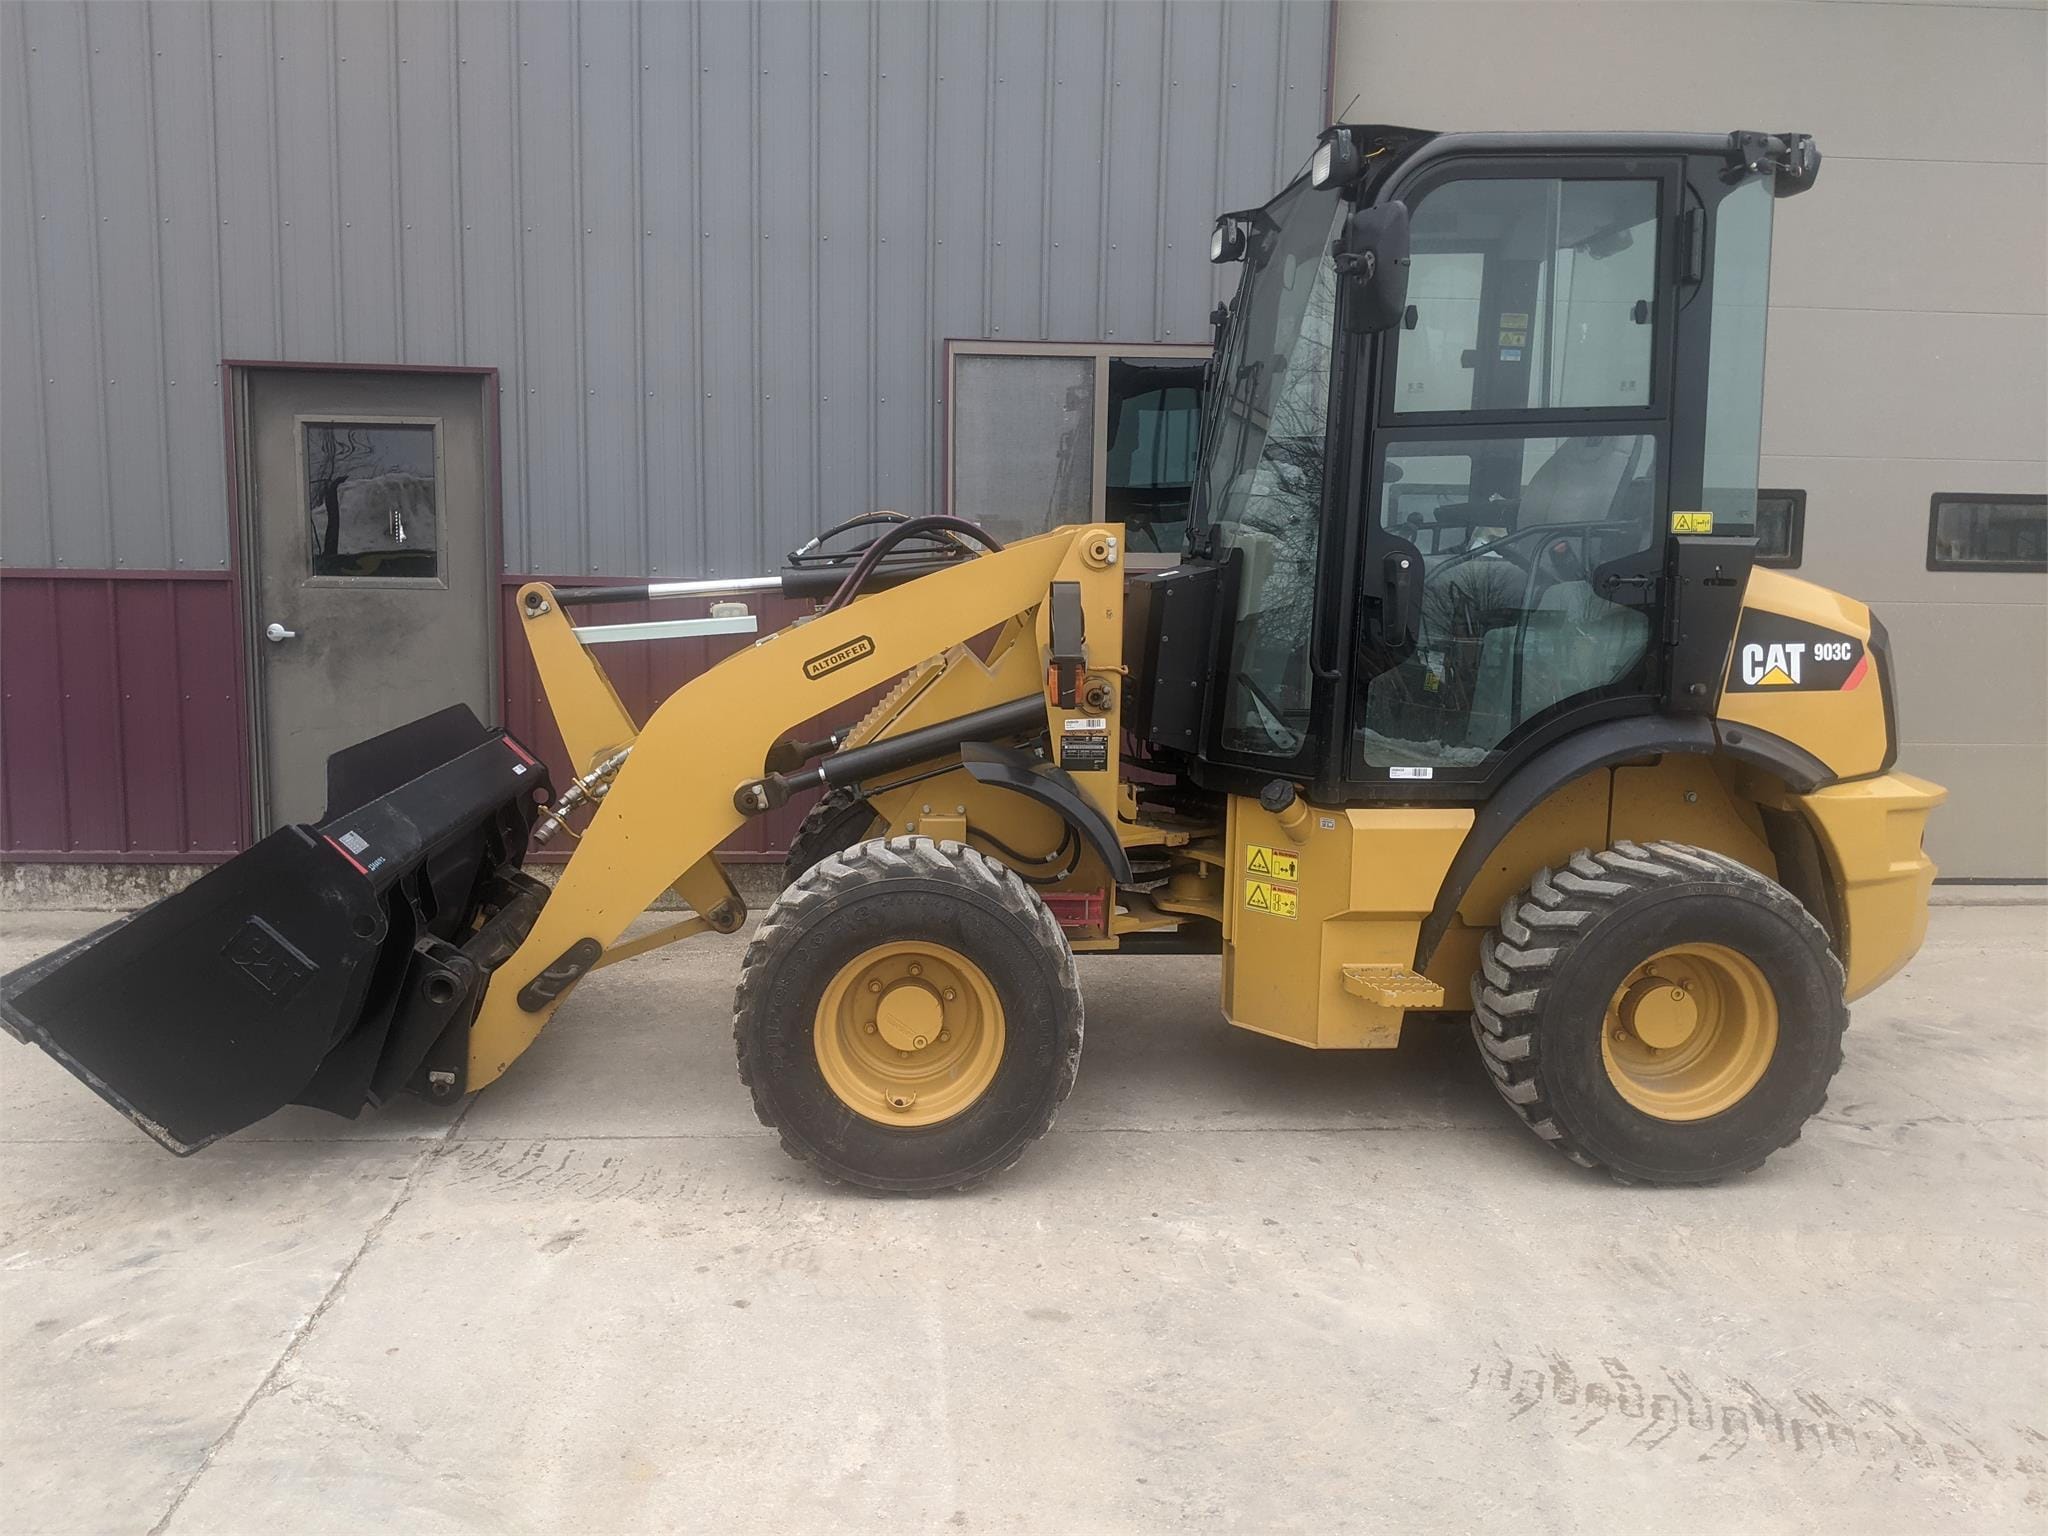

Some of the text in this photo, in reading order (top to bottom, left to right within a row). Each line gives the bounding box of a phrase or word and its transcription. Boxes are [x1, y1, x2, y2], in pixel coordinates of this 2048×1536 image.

[812, 643, 867, 673] ALTORFER
[1742, 642, 1851, 685] CAT 903C
[230, 936, 303, 996] CAT
